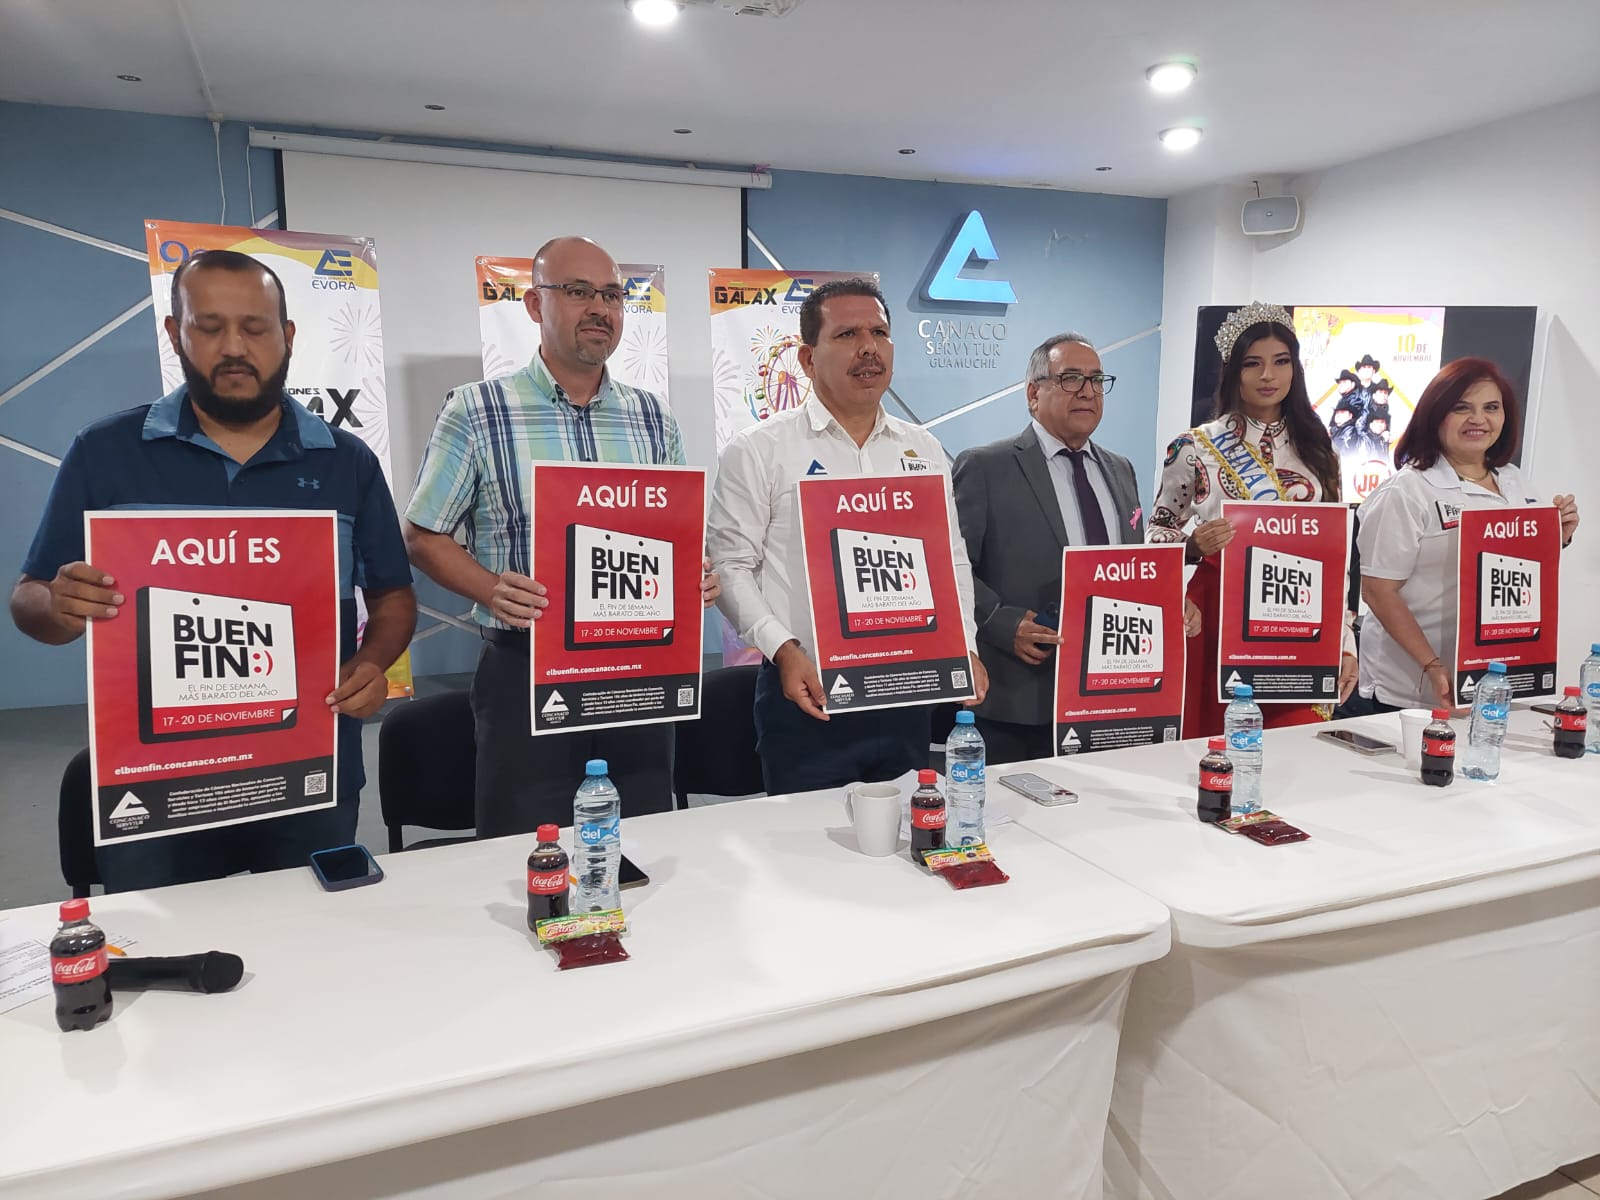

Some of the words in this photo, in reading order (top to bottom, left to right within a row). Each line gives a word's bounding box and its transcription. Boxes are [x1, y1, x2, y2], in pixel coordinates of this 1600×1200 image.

[312, 279, 357, 291] EVORA
[483, 281, 522, 301] GAL
[714, 286, 778, 306] GALAX
[623, 303, 653, 314] VORA
[918, 319, 1007, 341] CANACO
[1398, 333, 1416, 353] 10
[929, 358, 998, 369] GUAMUCHIL
[1210, 431, 1268, 489] REINA
[576, 479, 639, 509] AQUÍ
[645, 486, 668, 508] ES
[836, 486, 887, 514] AQUÍ
[892, 490, 914, 511] ES
[1253, 513, 1296, 535] AQUÍ
[1302, 518, 1320, 535] ES
[1483, 516, 1520, 539] AQUÍ
[1523, 520, 1538, 537] ES
[151, 530, 238, 566] AQUÍ
[248, 537, 281, 563] ES
[853, 547, 914, 569] BUEN
[592, 546, 659, 575] BUEN
[1093, 557, 1137, 582] AQUÍ
[1140, 561, 1157, 580] ES
[1262, 563, 1312, 587] BUEN
[1491, 568, 1531, 588] BUEN
[173, 613, 273, 647] BUEN
[604, 628, 615, 636] DE
[616, 626, 659, 636] NOVIEMBRE
[1103, 613, 1153, 635] BUEN
[187, 683, 197, 692] EL
[200, 683, 214, 692] FIN
[215, 683, 228, 691] DE
[229, 682, 267, 691] SEMANA
[202, 691, 237, 701] BARATO
[240, 690, 255, 699] DEL
[198, 713, 213, 724] DE
[215, 708, 276, 721] NOVIEMBRE
[114, 752, 254, 775] elbuenfin.concanaco.com.mx
[951, 768, 968, 779] ciel
[581, 824, 601, 840] ciel
